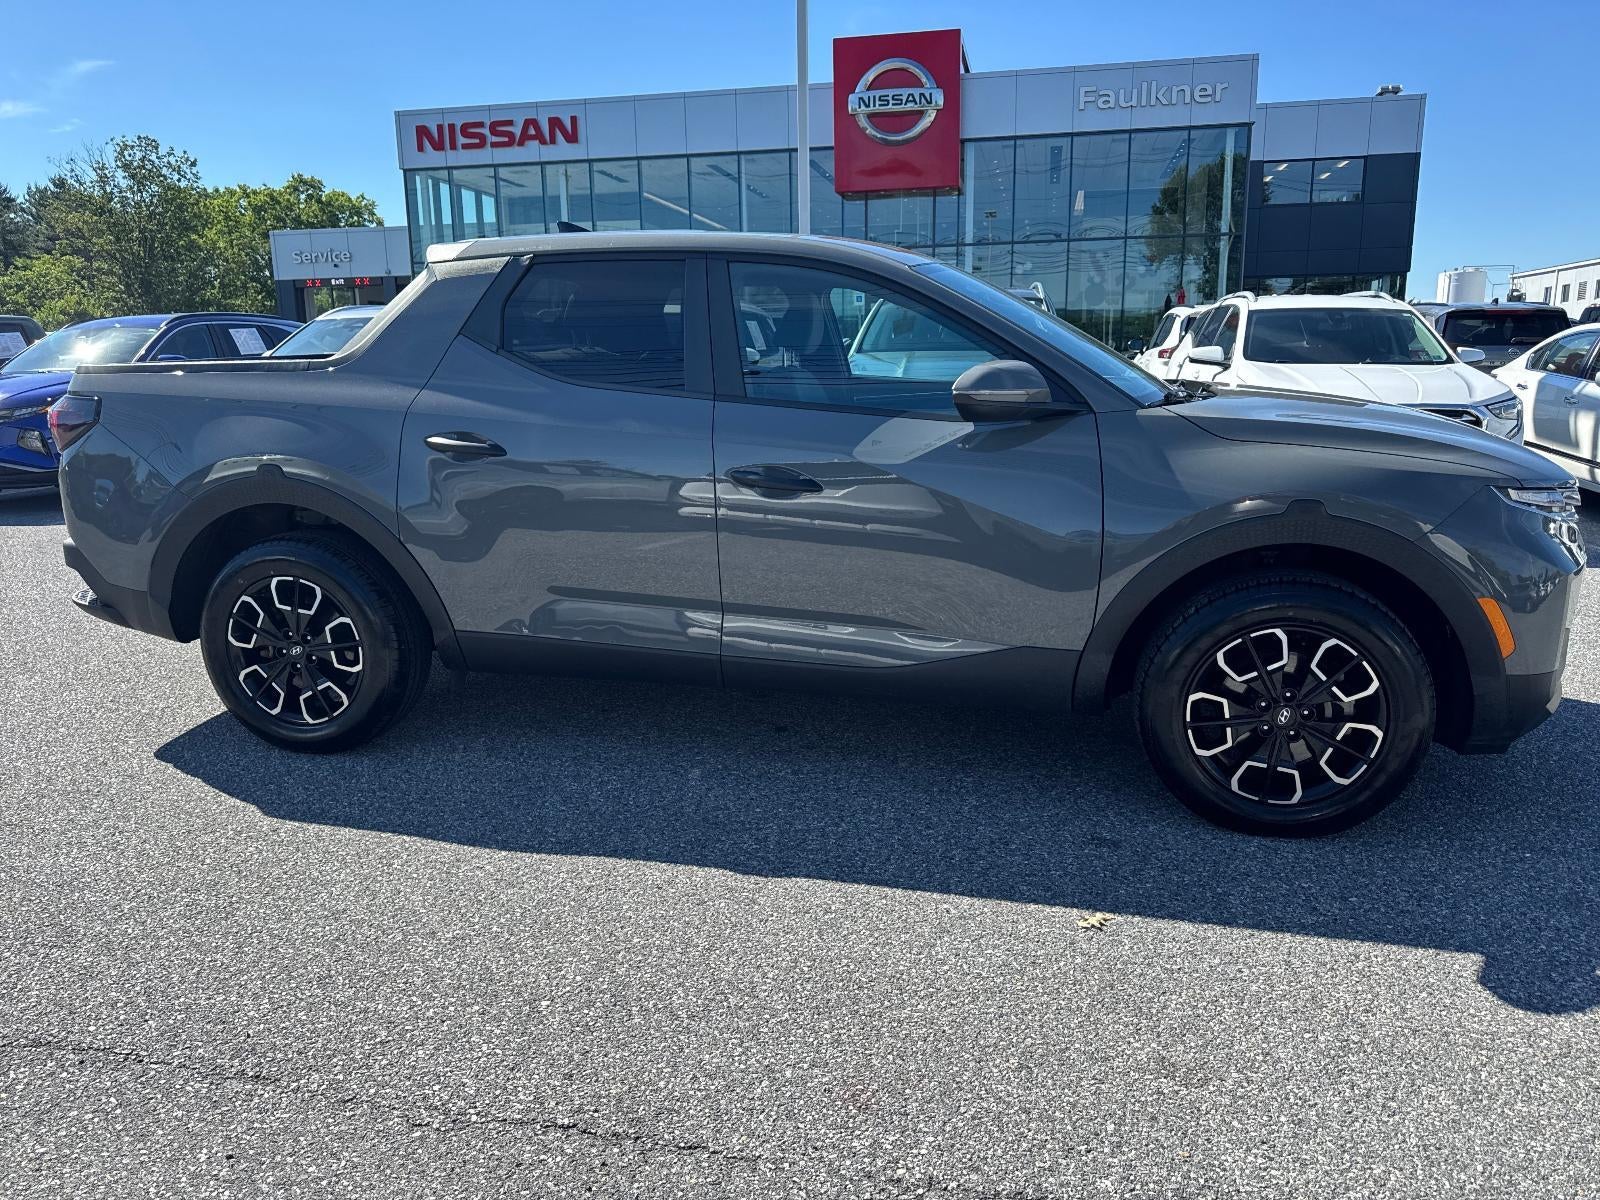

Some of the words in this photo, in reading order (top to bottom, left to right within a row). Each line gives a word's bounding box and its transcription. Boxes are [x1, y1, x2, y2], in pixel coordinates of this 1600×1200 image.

[858, 92, 933, 109] NISSAN
[1078, 80, 1230, 111] Faulkner
[415, 115, 579, 153] NISSAN
[292, 248, 351, 264] Service
